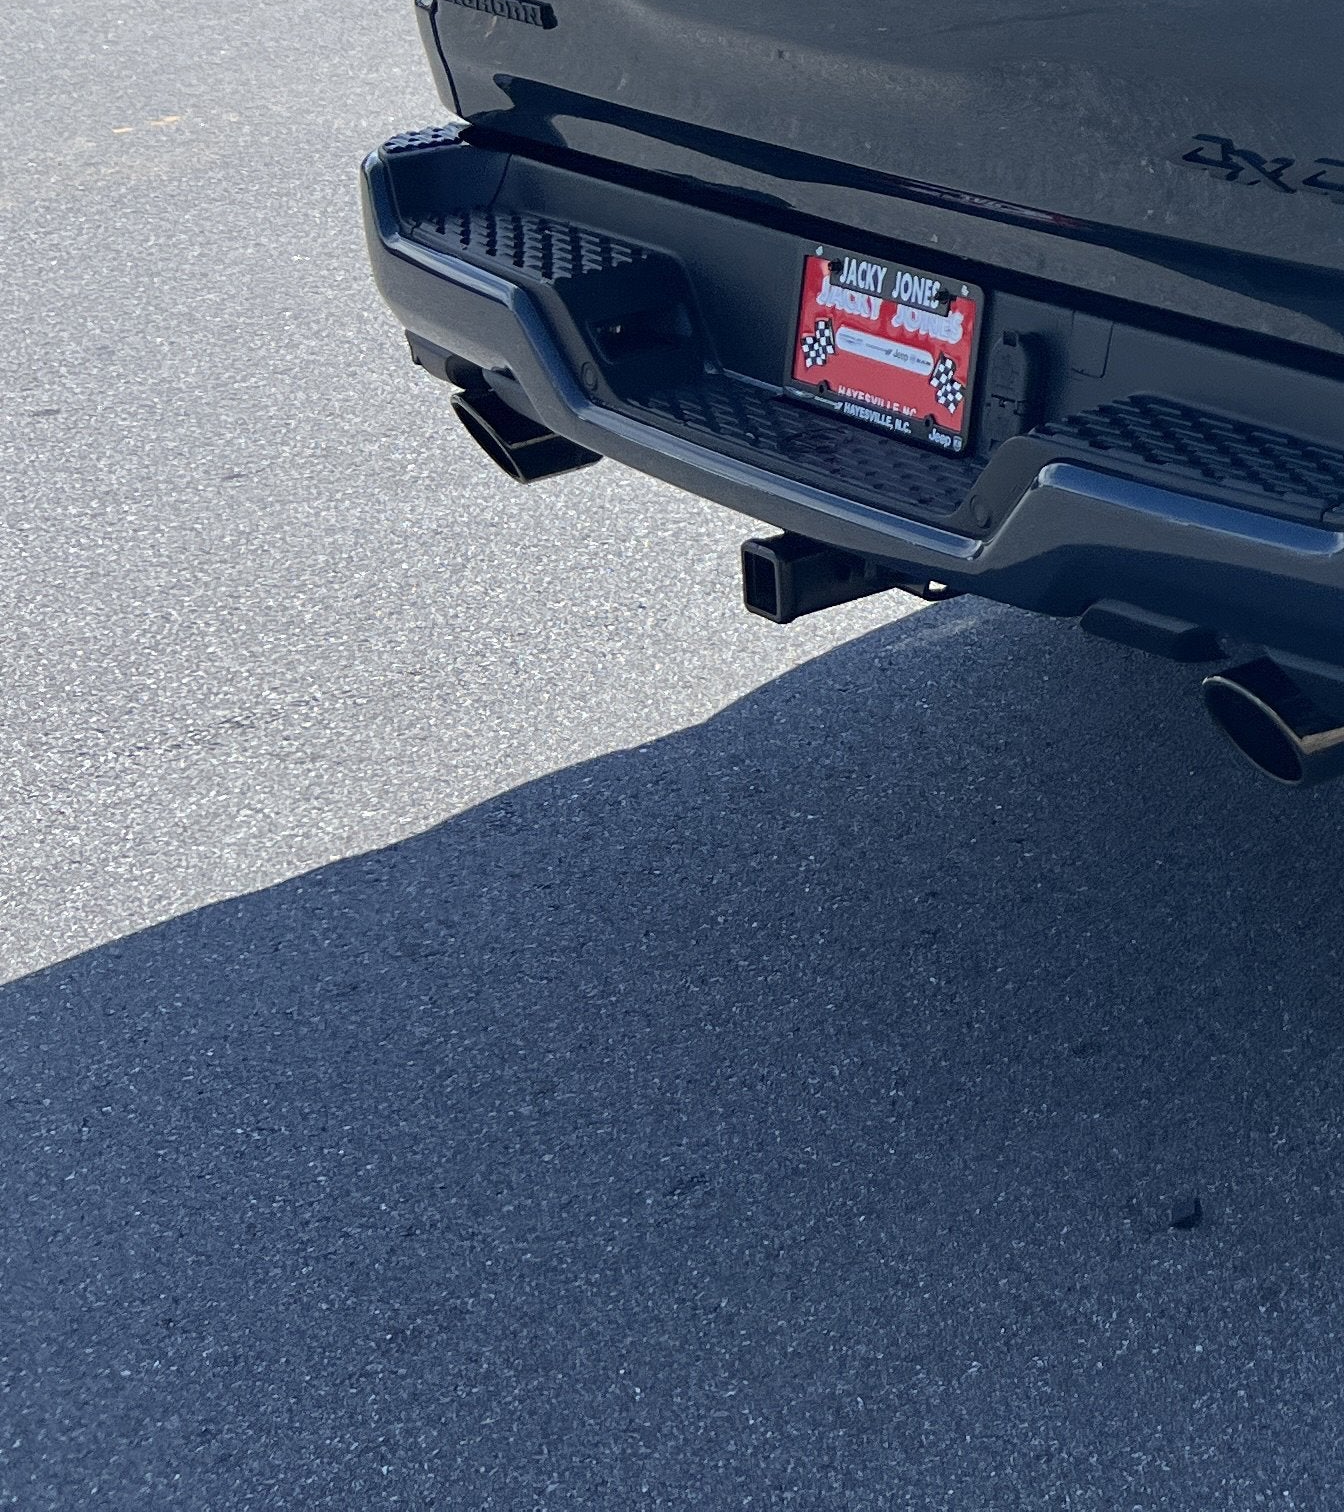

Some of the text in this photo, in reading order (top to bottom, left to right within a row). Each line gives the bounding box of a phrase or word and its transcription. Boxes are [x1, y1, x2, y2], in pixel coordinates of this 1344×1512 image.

[839, 256, 941, 309] JACKY JONES
[843, 401, 894, 430] HAYESVILLE,
[928, 427, 951, 448] Jeep
